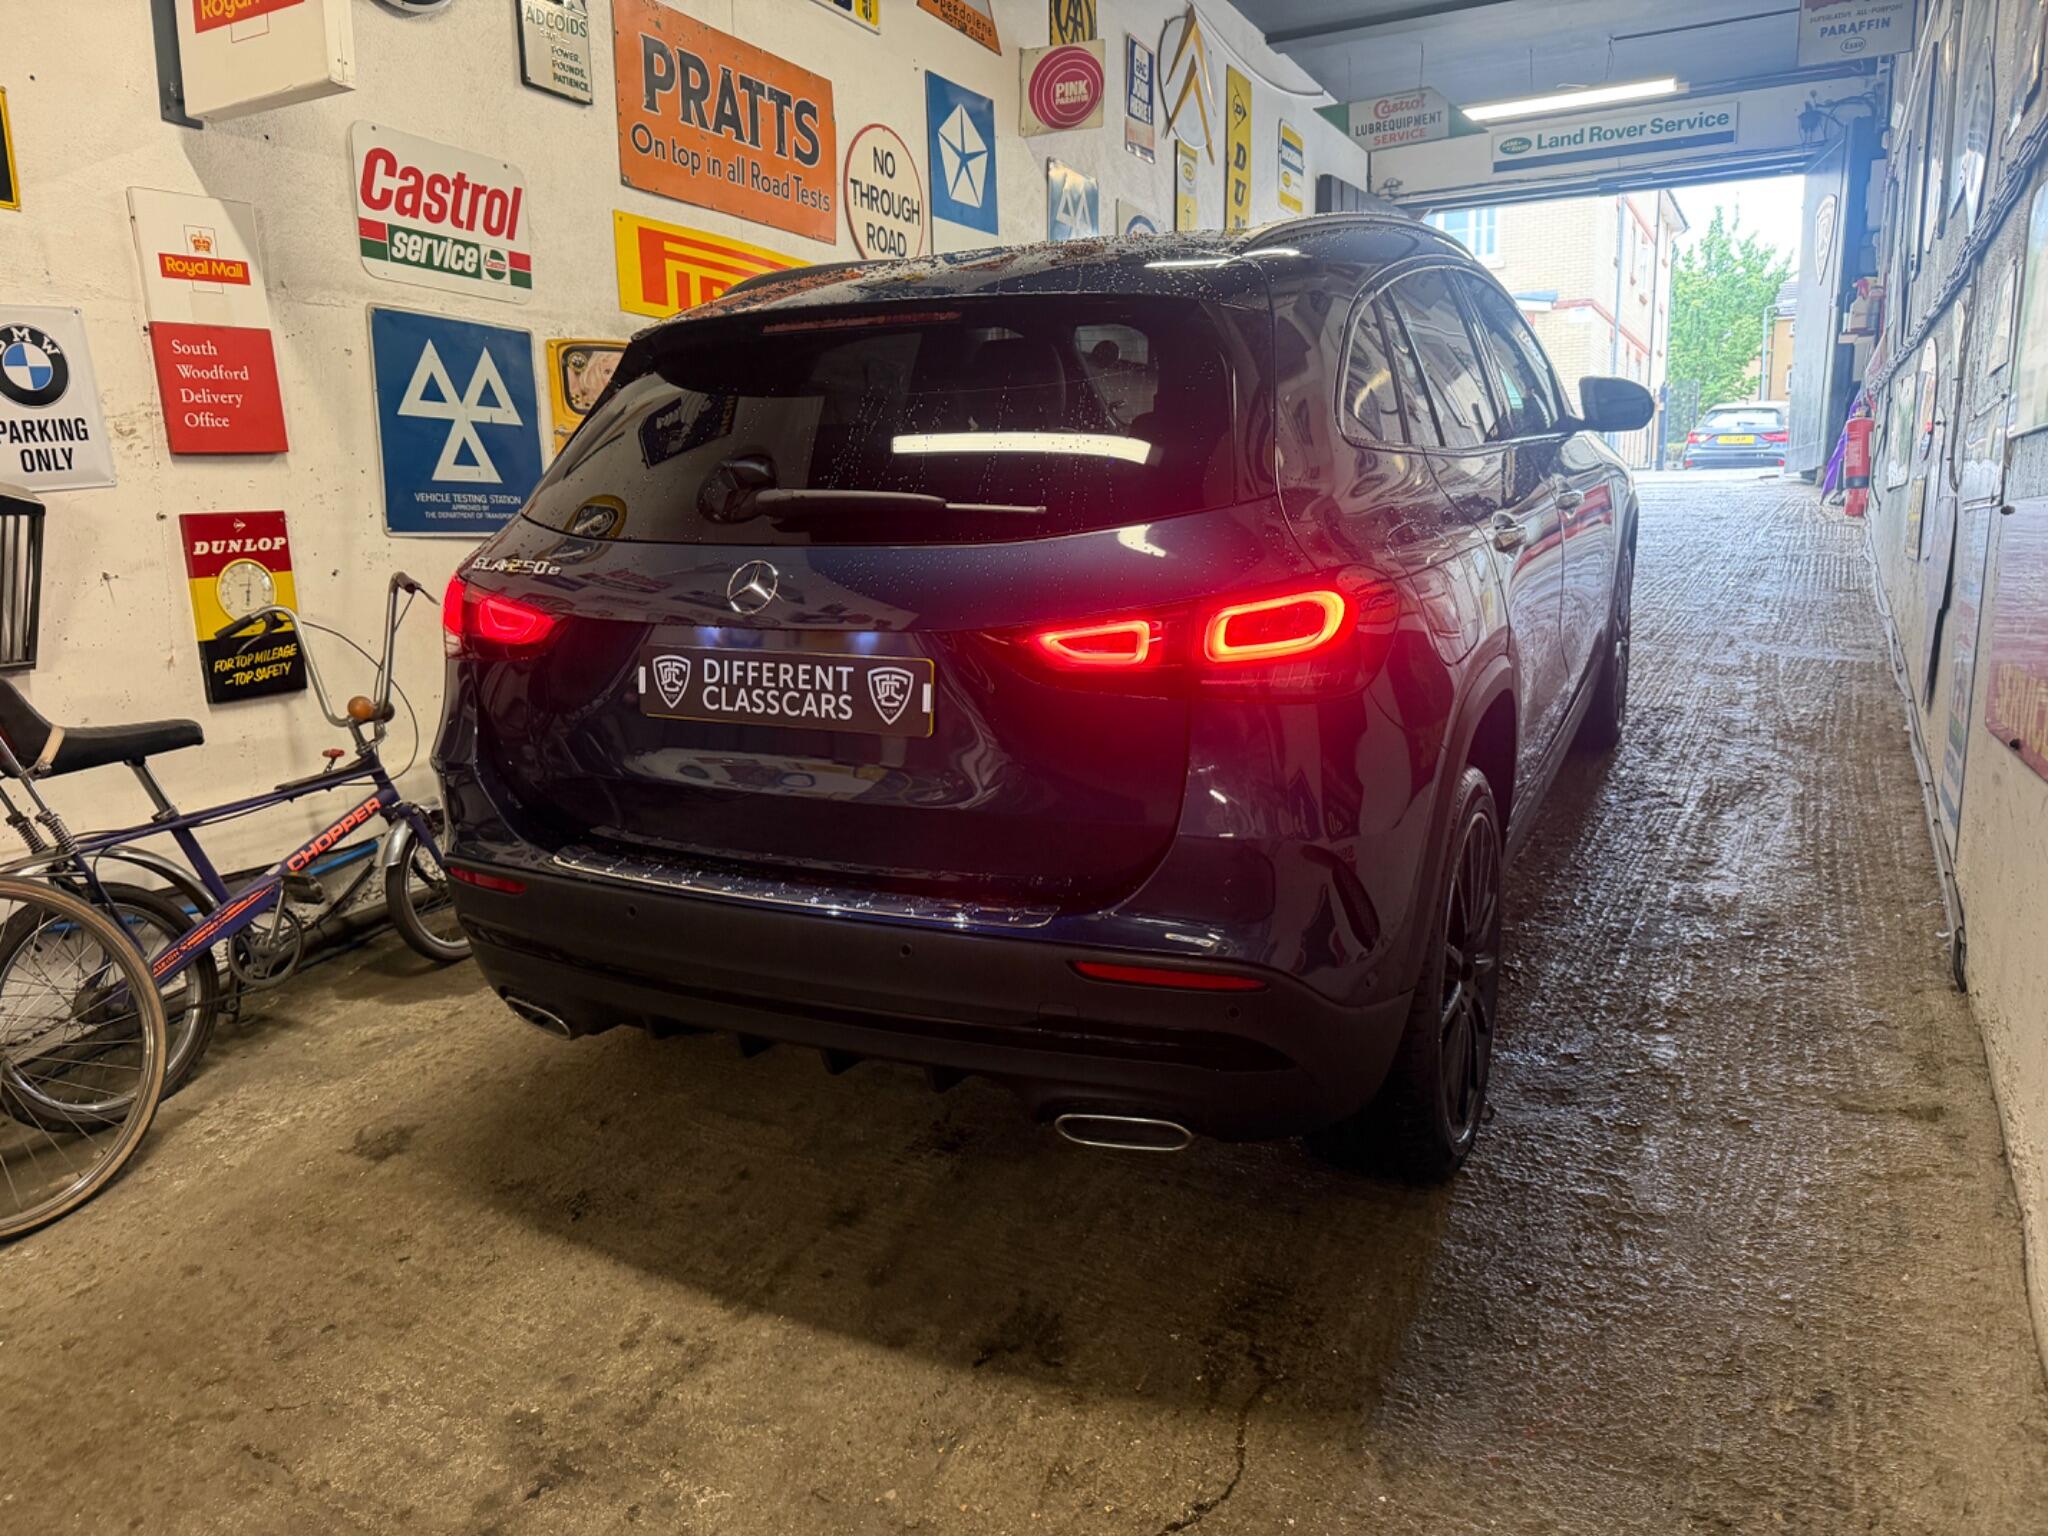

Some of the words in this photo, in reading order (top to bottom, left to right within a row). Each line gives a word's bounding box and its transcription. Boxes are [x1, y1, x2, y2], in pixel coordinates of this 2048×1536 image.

[202, 0, 252, 19] Roya
[525, 6, 587, 38] ADCOIDS
[932, 0, 992, 37] peedolene
[1820, 17, 1891, 38] PARAFFIN
[640, 33, 821, 169] PRATTS
[1055, 79, 1088, 99] PINK
[1373, 92, 1427, 119] Castrol
[1355, 111, 1442, 137] LUBREQUIPMENT
[1374, 128, 1426, 146] SERVICE
[1537, 128, 1584, 150] Land
[1589, 123, 1647, 144] Rover
[1650, 111, 1730, 135] Service
[631, 122, 666, 160] On
[671, 136, 701, 177] top
[706, 149, 722, 178] in
[727, 156, 746, 186] all
[751, 161, 790, 200] Road
[792, 175, 831, 212] Tests
[873, 146, 896, 179] NO
[360, 147, 523, 241] Castrol
[850, 178, 920, 226] THROUGH
[391, 231, 479, 273] service
[866, 222, 907, 258] ROAD
[165, 256, 209, 279] Royal
[212, 262, 243, 279] Mail
[171, 339, 218, 356] South
[176, 364, 249, 381] Woodford
[180, 388, 243, 408] Delivery
[184, 412, 230, 428] Office
[20, 447, 74, 473] ONLY
[414, 492, 450, 503] VEHICLE
[452, 493, 488, 504] TESTING
[489, 494, 521, 504] STATION
[425, 511, 437, 519] THE
[438, 511, 475, 519] DEPARTMENT
[193, 537, 287, 555] DUNLOP
[214, 657, 236, 673] FOR
[234, 653, 255, 668] TOP
[254, 643, 298, 664] MILEAGE
[253, 661, 292, 682] SAFETY
[703, 658, 854, 692] DIFFERENT
[702, 686, 853, 720] CLASSCARS
[286, 796, 382, 873] CHOPPER
